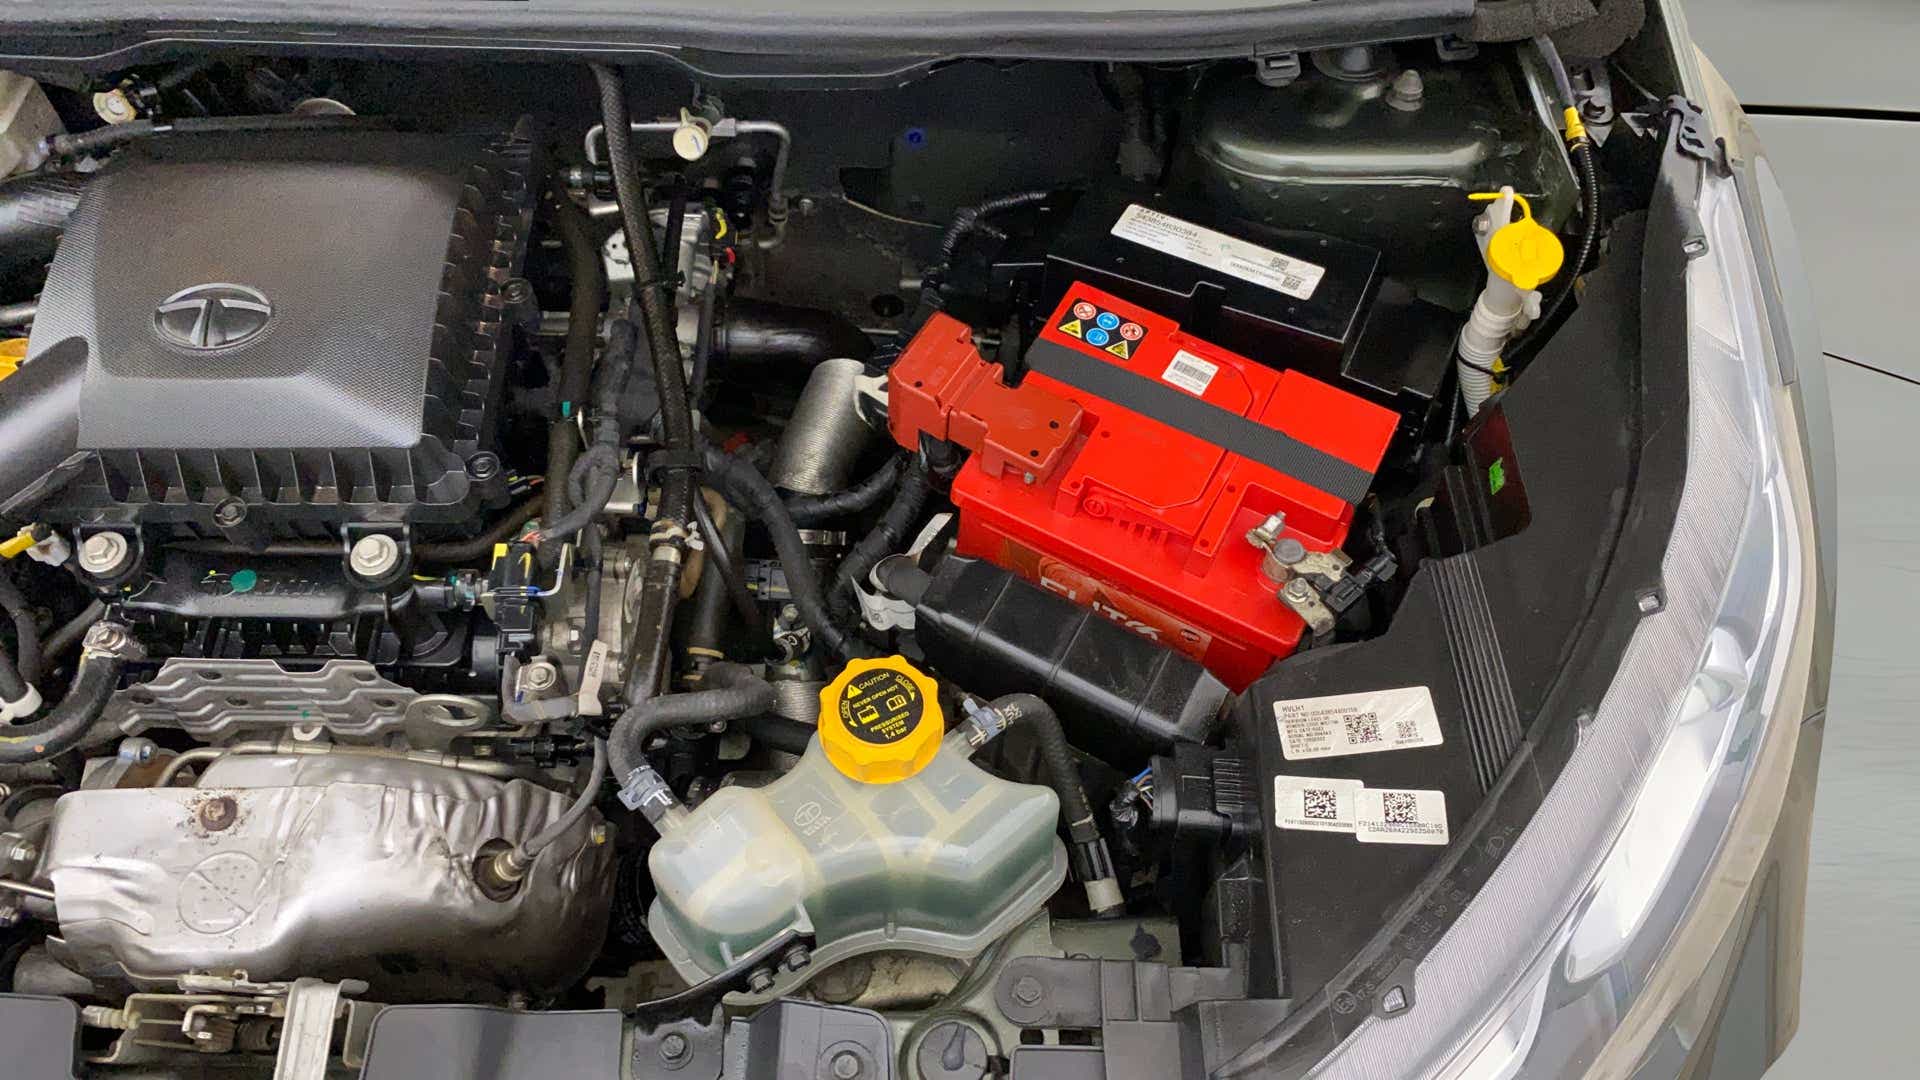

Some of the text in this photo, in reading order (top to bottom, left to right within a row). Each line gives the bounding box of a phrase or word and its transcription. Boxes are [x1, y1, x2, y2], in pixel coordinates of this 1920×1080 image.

[858, 672, 890, 690] CAUTION
[895, 674, 915, 692] CLOSE
[852, 684, 899, 709] NEVER OPEN HOT
[841, 699, 849, 719] OPEN
[881, 720, 905, 734] SYSTEM
[895, 726, 907, 736] bar
